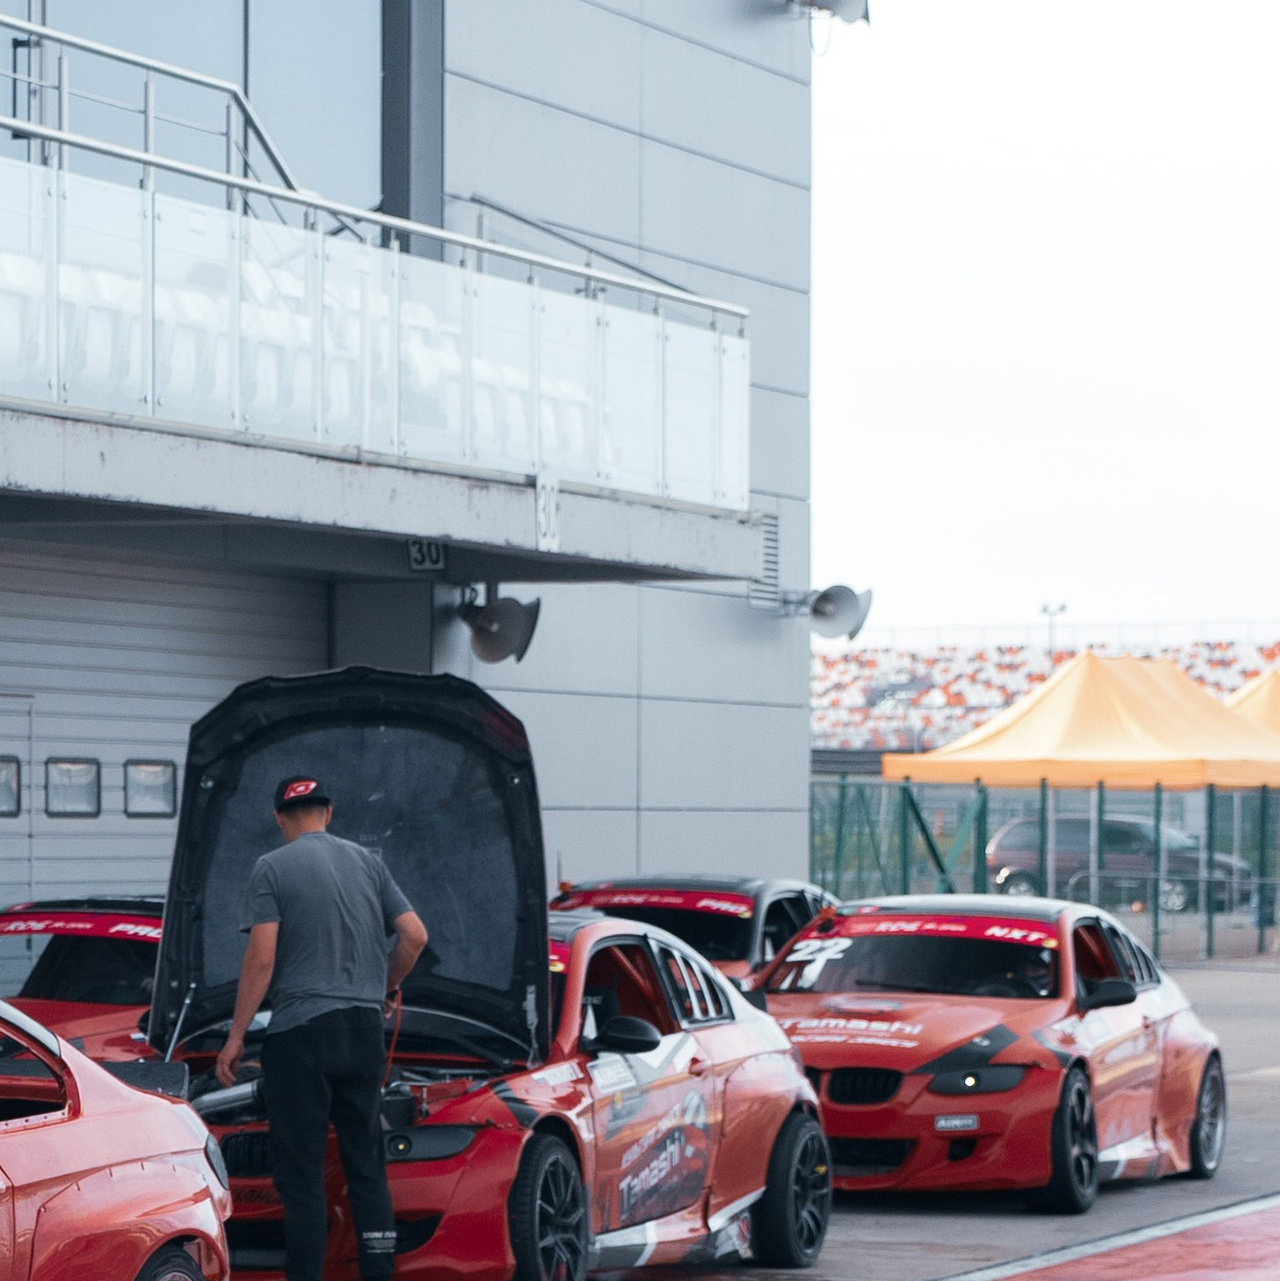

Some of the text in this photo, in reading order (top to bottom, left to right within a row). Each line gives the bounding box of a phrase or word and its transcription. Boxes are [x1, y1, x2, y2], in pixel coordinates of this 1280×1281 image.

[412, 540, 441, 565] 30
[984, 925, 1048, 942] NXT
[619, 1129, 684, 1220] Tamashi
